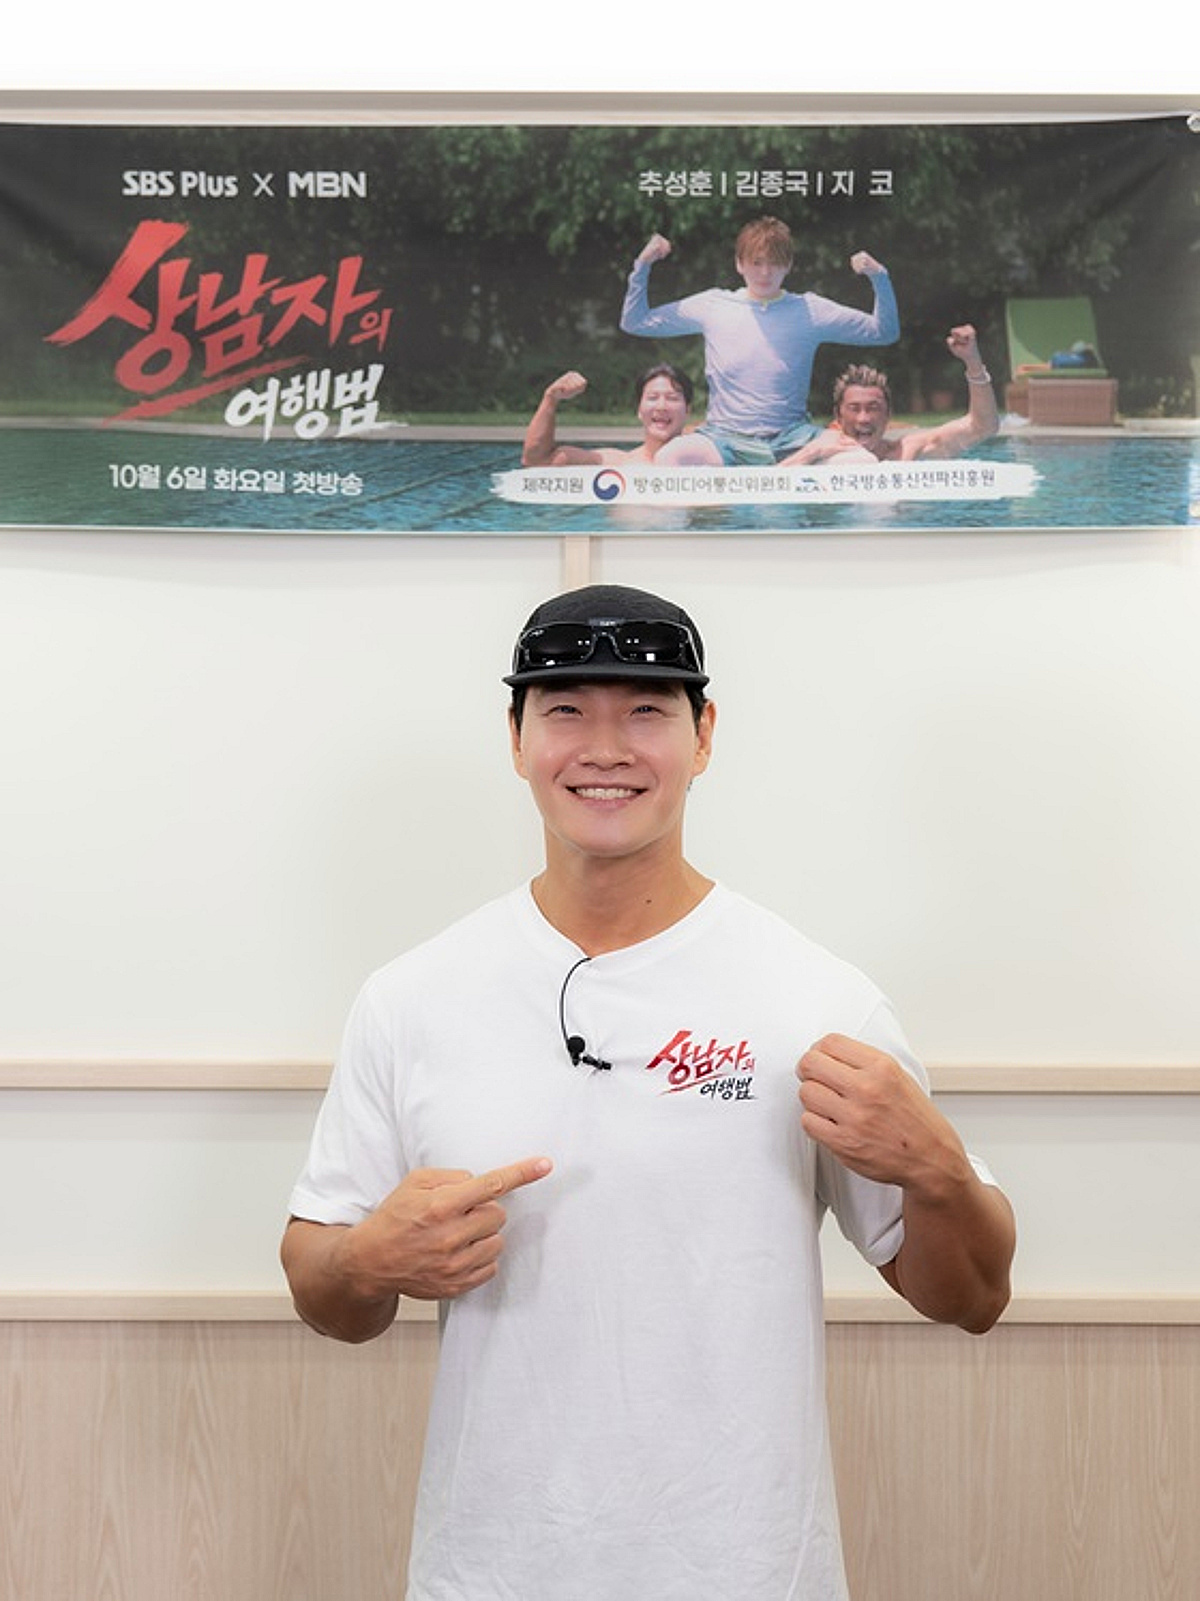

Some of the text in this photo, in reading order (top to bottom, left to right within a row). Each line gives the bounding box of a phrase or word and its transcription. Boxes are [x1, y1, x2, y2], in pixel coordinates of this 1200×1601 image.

[122, 170, 174, 196] SBS
[180, 170, 238, 197] Plus
[288, 171, 367, 198] MBN
[638, 170, 713, 197] 추성훈
[735, 170, 809, 197] 김종국
[43, 219, 393, 395] 상남자의
[224, 363, 409, 443] 여행범
[108, 464, 365, 496] 10월 6일 화요일 첫방송
[521, 477, 585, 493] 제작지원
[633, 476, 791, 493] 방송미디어통신위원회
[830, 469, 996, 491] 한국방송통신전파진흥원
